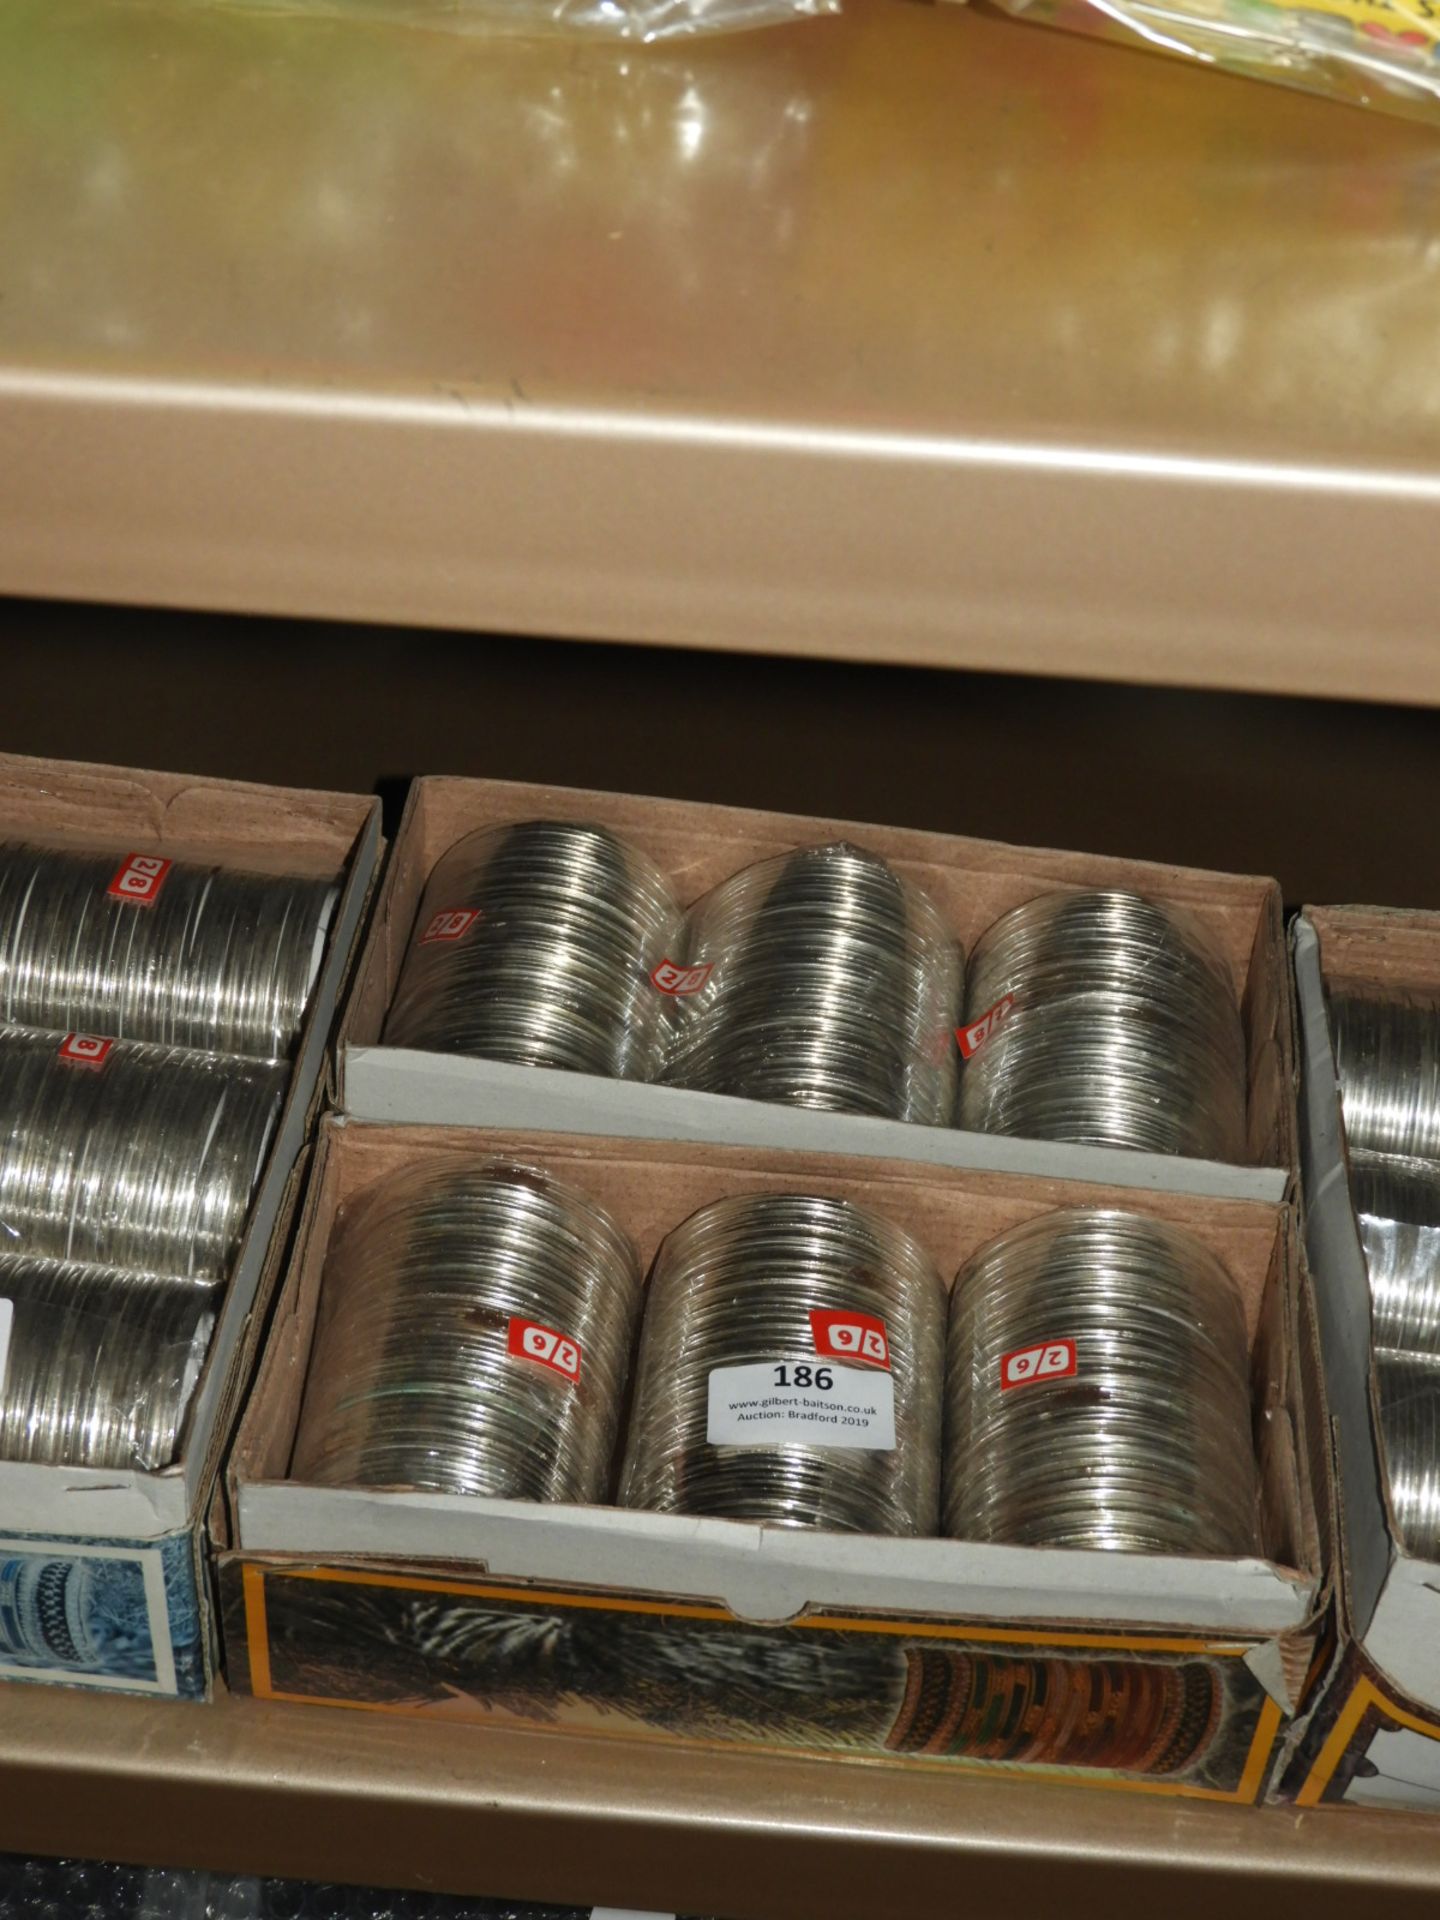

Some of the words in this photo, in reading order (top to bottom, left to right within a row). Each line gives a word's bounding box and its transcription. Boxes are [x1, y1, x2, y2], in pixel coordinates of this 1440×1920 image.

[773, 1365, 834, 1391] 186
[728, 1397, 877, 1415] www.gilbert-baitson.co.uk
[737, 1410, 785, 1421] Auction:
[787, 1410, 838, 1424] Bradford
[840, 1415, 870, 1427] 2019
